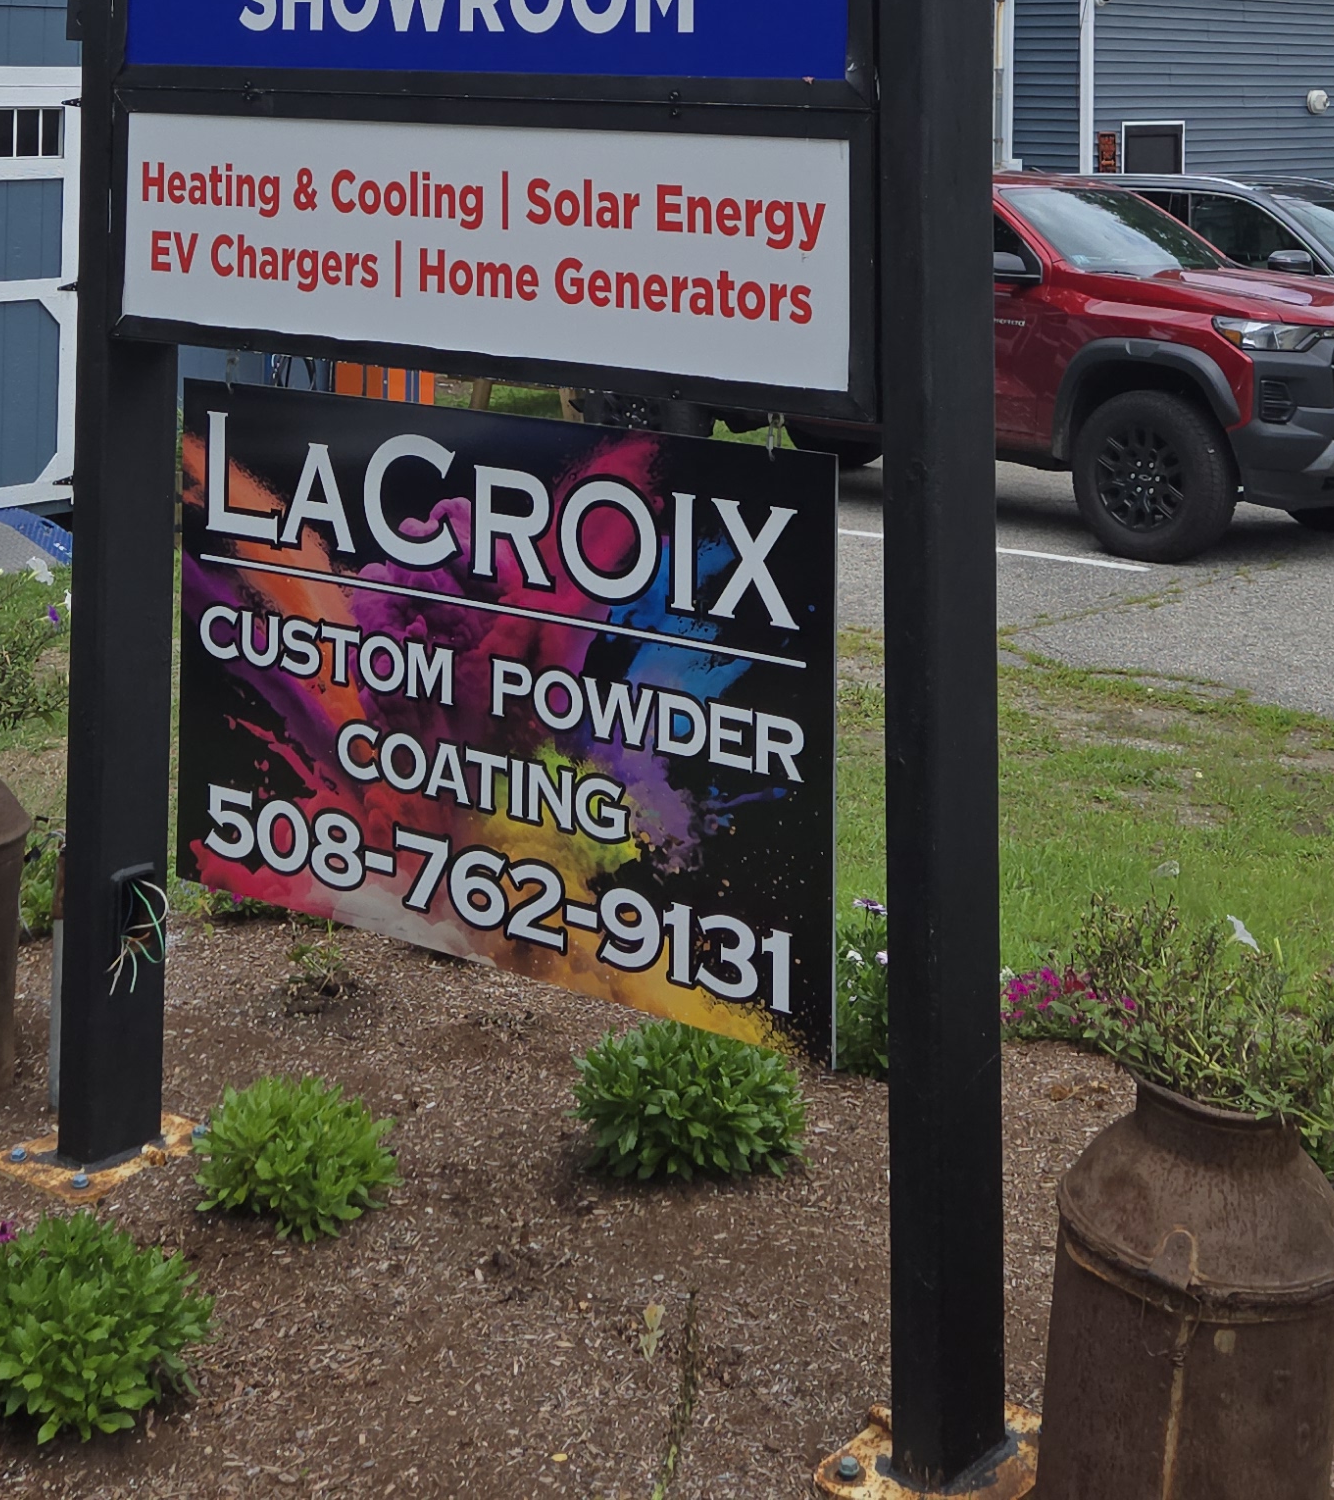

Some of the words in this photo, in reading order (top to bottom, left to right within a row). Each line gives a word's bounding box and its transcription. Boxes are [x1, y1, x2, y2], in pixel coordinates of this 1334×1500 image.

[141, 160, 280, 217] Heating
[292, 167, 318, 211] &
[331, 168, 485, 231] Cooling
[525, 177, 643, 231] Solar
[656, 183, 827, 253] Energy
[150, 230, 199, 274] EV
[210, 233, 379, 293] Chargers
[418, 247, 539, 302] Home
[554, 257, 813, 326] Generators
[206, 410, 799, 630] LACROIX
[199, 605, 454, 706] CUSTOM
[492, 658, 806, 783] POWDER
[337, 724, 629, 842] COATING
[204, 783, 794, 1015] 508-762-9131
